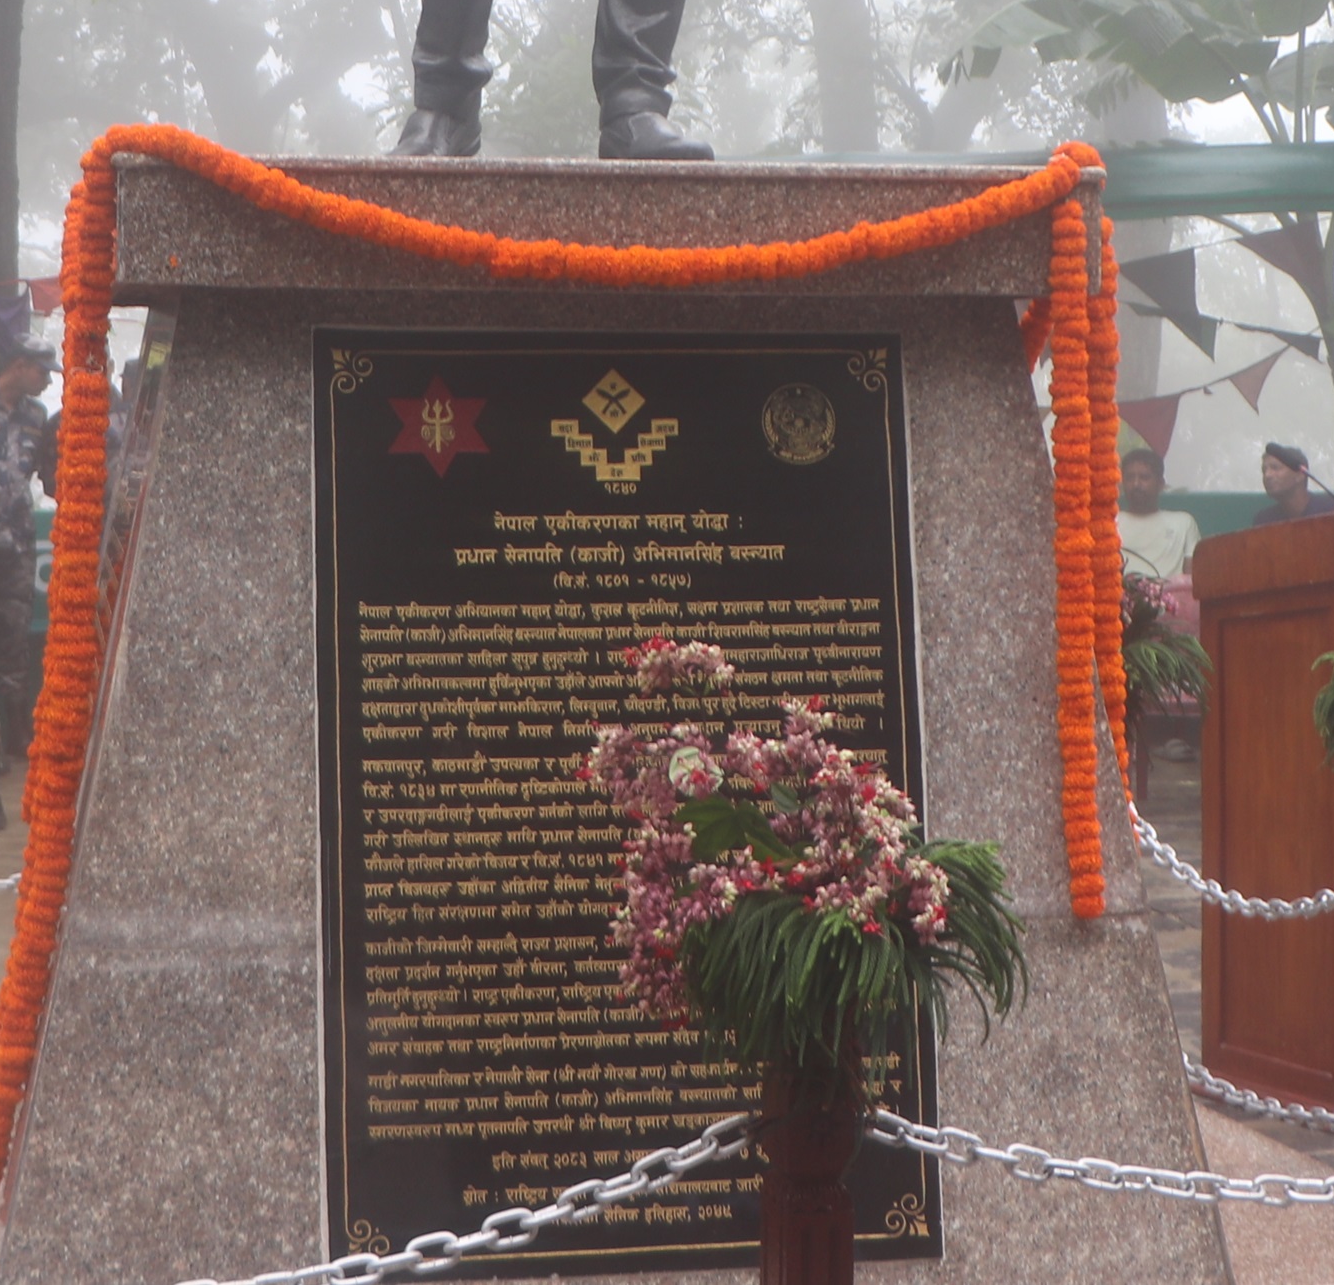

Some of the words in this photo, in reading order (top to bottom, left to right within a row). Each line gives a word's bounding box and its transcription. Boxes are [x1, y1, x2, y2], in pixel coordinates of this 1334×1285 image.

[493, 510, 538, 531] नेपाल
[543, 509, 640, 536] एकीकरणका
[645, 513, 686, 533] महान्
[691, 509, 729, 531] योद्धा
[453, 548, 498, 565] प्रधान
[503, 541, 563, 563] सेनापति
[569, 540, 625, 565] (काजी)
[632, 539, 724, 564] अभिमानसिंह
[595, 573, 629, 588] १८०१
[649, 572, 692, 590] १८५७)
[358, 600, 393, 618] नेपाल
[395, 600, 452, 622] एकीकरण
[454, 599, 518, 618] अभियानका
[520, 603, 551, 619] महान्
[588, 602, 623, 621] कुशल
[686, 600, 718, 616] सक्षम
[720, 600, 764, 615] प्रशासक
[766, 599, 790, 612] तथा
[849, 598, 881, 612] प्रधान
[358, 623, 404, 642] सेनापति
[404, 623, 446, 644] (काजी)
[447, 622, 514, 645] अभिमानसिंह
[557, 621, 603, 641] नेपालका
[676, 621, 708, 638] काजी
[812, 622, 836, 635] तथा
[360, 672, 399, 693] शाहको
[770, 670, 804, 685] क्षमता
[805, 669, 828, 683] तथा
[830, 664, 883, 687] कूटनीतिक
[361, 721, 422, 743] एकीकरण
[431, 721, 458, 740] गरी
[466, 720, 509, 740] विशाल
[517, 720, 554, 738] नेपाल
[488, 756, 540, 772] उपत्यका
[543, 757, 555, 771] र
[399, 782, 436, 801] १८३४
[439, 783, 457, 796] मा
[458, 776, 518, 797] रणनीतिक
[362, 808, 375, 824] र
[476, 801, 535, 824] एकीकरण
[576, 799, 608, 818] लागि
[363, 828, 389, 848] गरी
[505, 824, 538, 843] माथि
[539, 829, 574, 844] प्रधान
[576, 824, 623, 843] सेनापति
[406, 852, 446, 873] हासिल
[446, 851, 483, 870] गरेको
[519, 854, 530, 869] र
[363, 882, 394, 898] प्राप्त
[552, 872, 590, 893] सैनिक
[411, 902, 436, 922] हित
[500, 899, 530, 919] समेत
[364, 936, 414, 956] काजीको
[520, 936, 551, 952] राज्य
[365, 964, 401, 983] दक्षता
[499, 981, 560, 1004] एकीकरण,
[520, 1010, 555, 1026] प्रधान
[556, 1005, 600, 1024] सेनापति
[602, 1004, 645, 1025] (काजी)
[366, 1040, 400, 1056] अमर
[445, 1038, 474, 1053] तथा
[399, 1067, 472, 1088] नगरपालिका
[472, 1071, 485, 1086] र
[484, 1064, 524, 1084] नेपाली
[525, 1065, 550, 1083] सेना
[639, 1064, 667, 1081] गण)
[670, 1060, 688, 1078] को
[424, 1097, 460, 1112] नायक
[464, 1096, 499, 1111] प्रधान
[503, 1089, 549, 1109] सेनापति
[554, 1087, 599, 1109] (काजी)
[603, 1085, 673, 1106] अभिमानसिंह
[578, 1112, 597, 1131] श्री
[636, 1114, 669, 1134] कुमार
[491, 1150, 517, 1172] इति
[592, 1149, 620, 1166] साल
